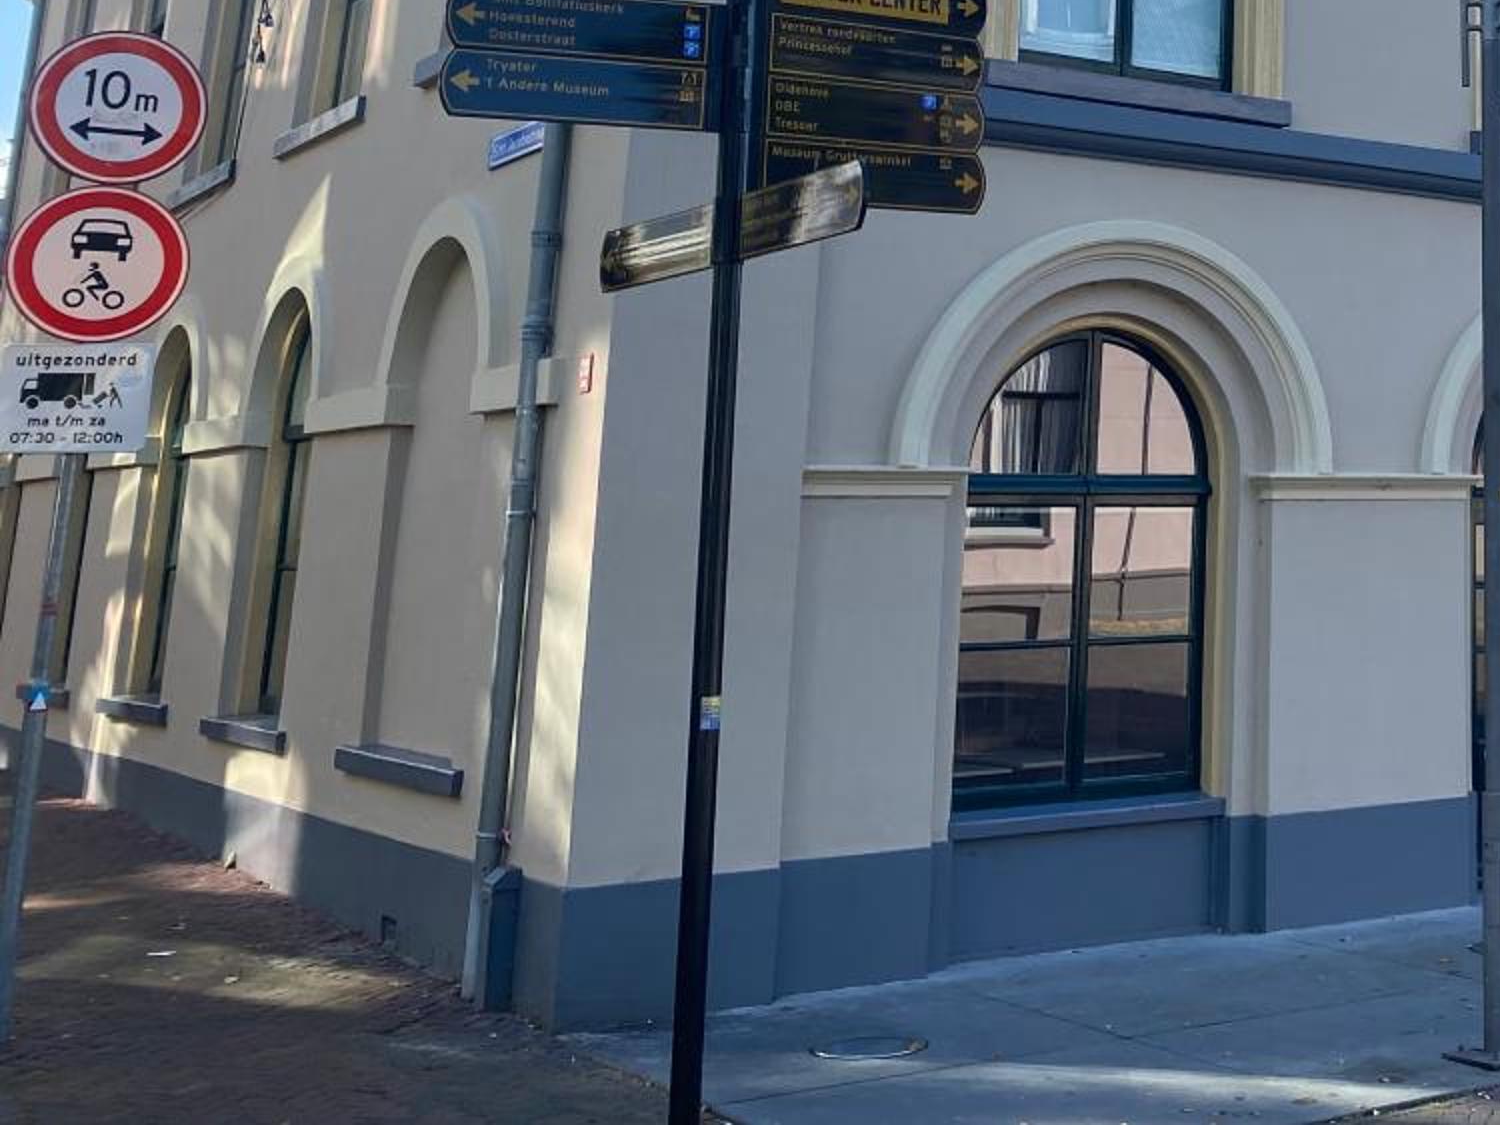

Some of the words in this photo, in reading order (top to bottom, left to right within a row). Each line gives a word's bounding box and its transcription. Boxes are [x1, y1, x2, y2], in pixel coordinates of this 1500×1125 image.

[16, 353, 137, 370] uitgezonderd
[28, 417, 49, 427] ma
[55, 414, 83, 427] t/m
[90, 417, 106, 427] za
[9, 431, 55, 444] 07:30
[73, 431, 123, 444] 12:00h
